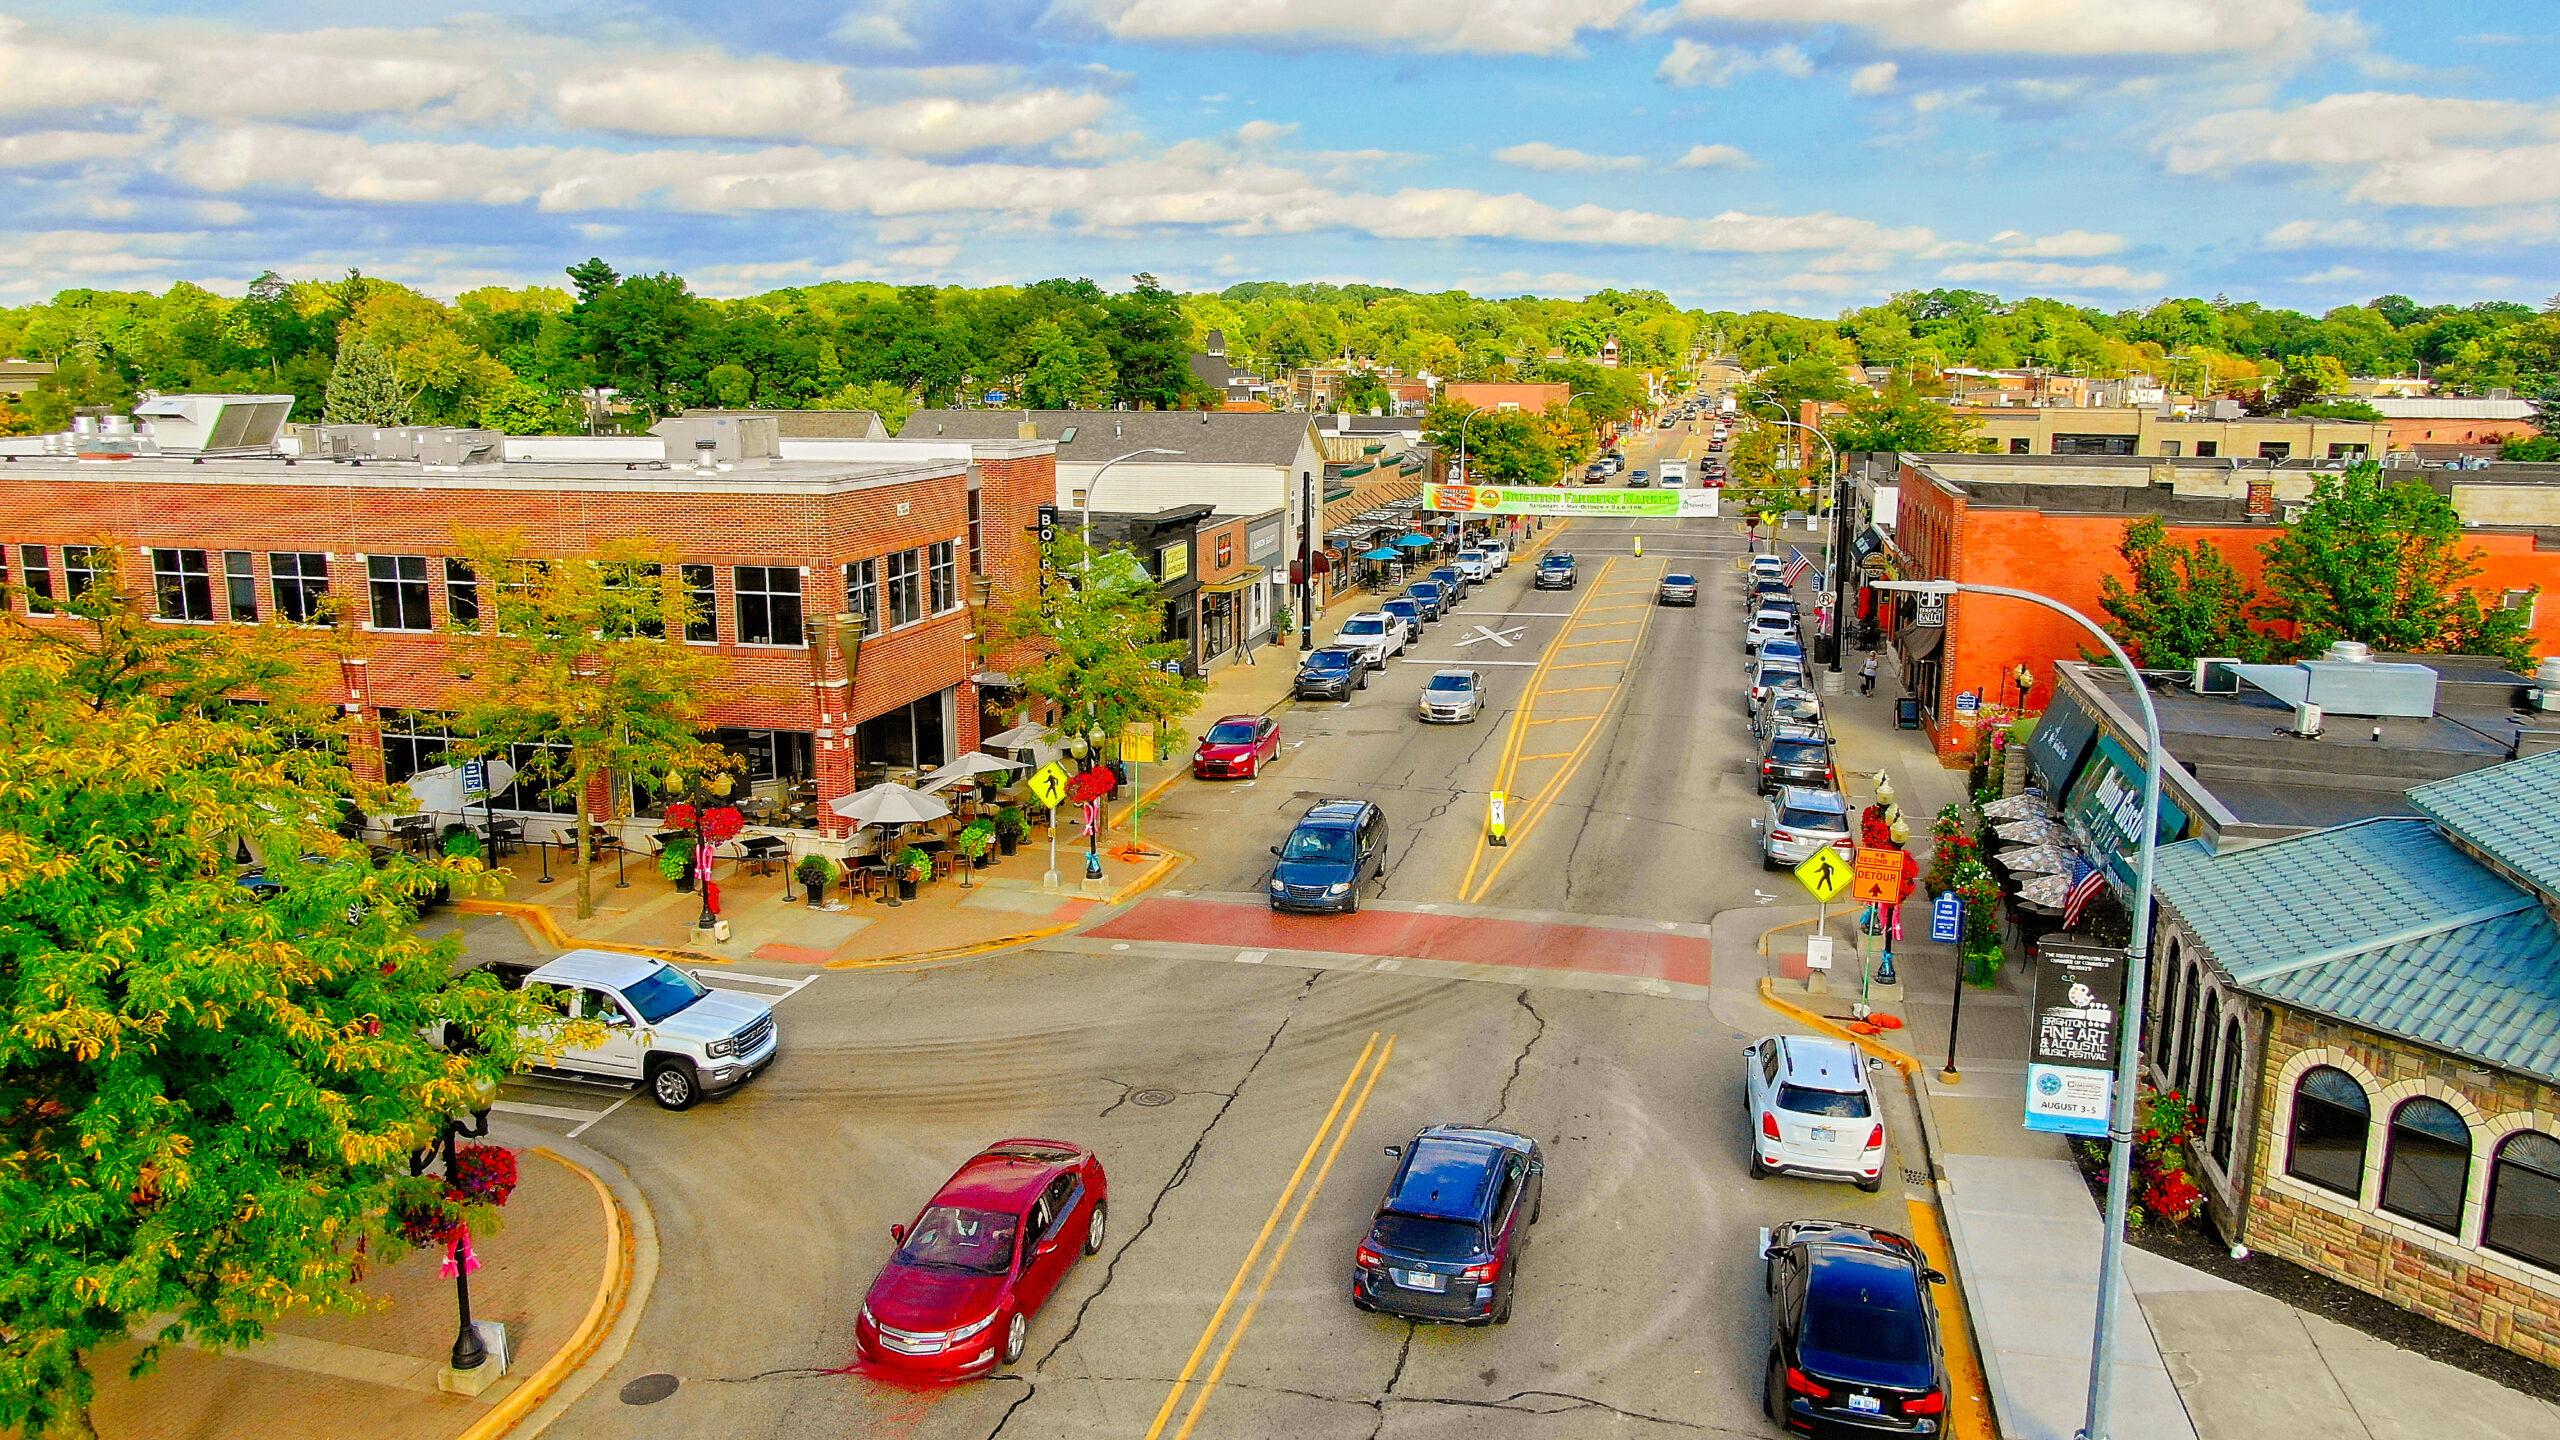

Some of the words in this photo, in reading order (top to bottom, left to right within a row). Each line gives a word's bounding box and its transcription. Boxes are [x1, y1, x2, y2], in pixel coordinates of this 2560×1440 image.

[1502, 491, 1562, 503] BRIGHTON
[1623, 493, 1674, 505] MARKET
[2095, 766, 2124, 815] Buon
[2114, 789, 2144, 843] Gusto
[2090, 812, 2119, 854] BISTRO
[1860, 857, 1888, 865] SECOND
[1857, 870, 1897, 882] DETOUR
[2041, 1016, 2087, 1028] BRIGHTON
[2040, 1025, 2075, 1040] FINE
[2077, 1028, 2110, 1044] ART
[2040, 1038, 2049, 1048] &
[2051, 1038, 2108, 1053] ACOUSTIC
[2039, 1047, 2067, 1057] MUSIC
[2068, 1050, 2107, 1061] FESTIVAL
[2041, 1101, 2078, 1112] AUGUST
[2080, 1105, 2096, 1114] 3-5
